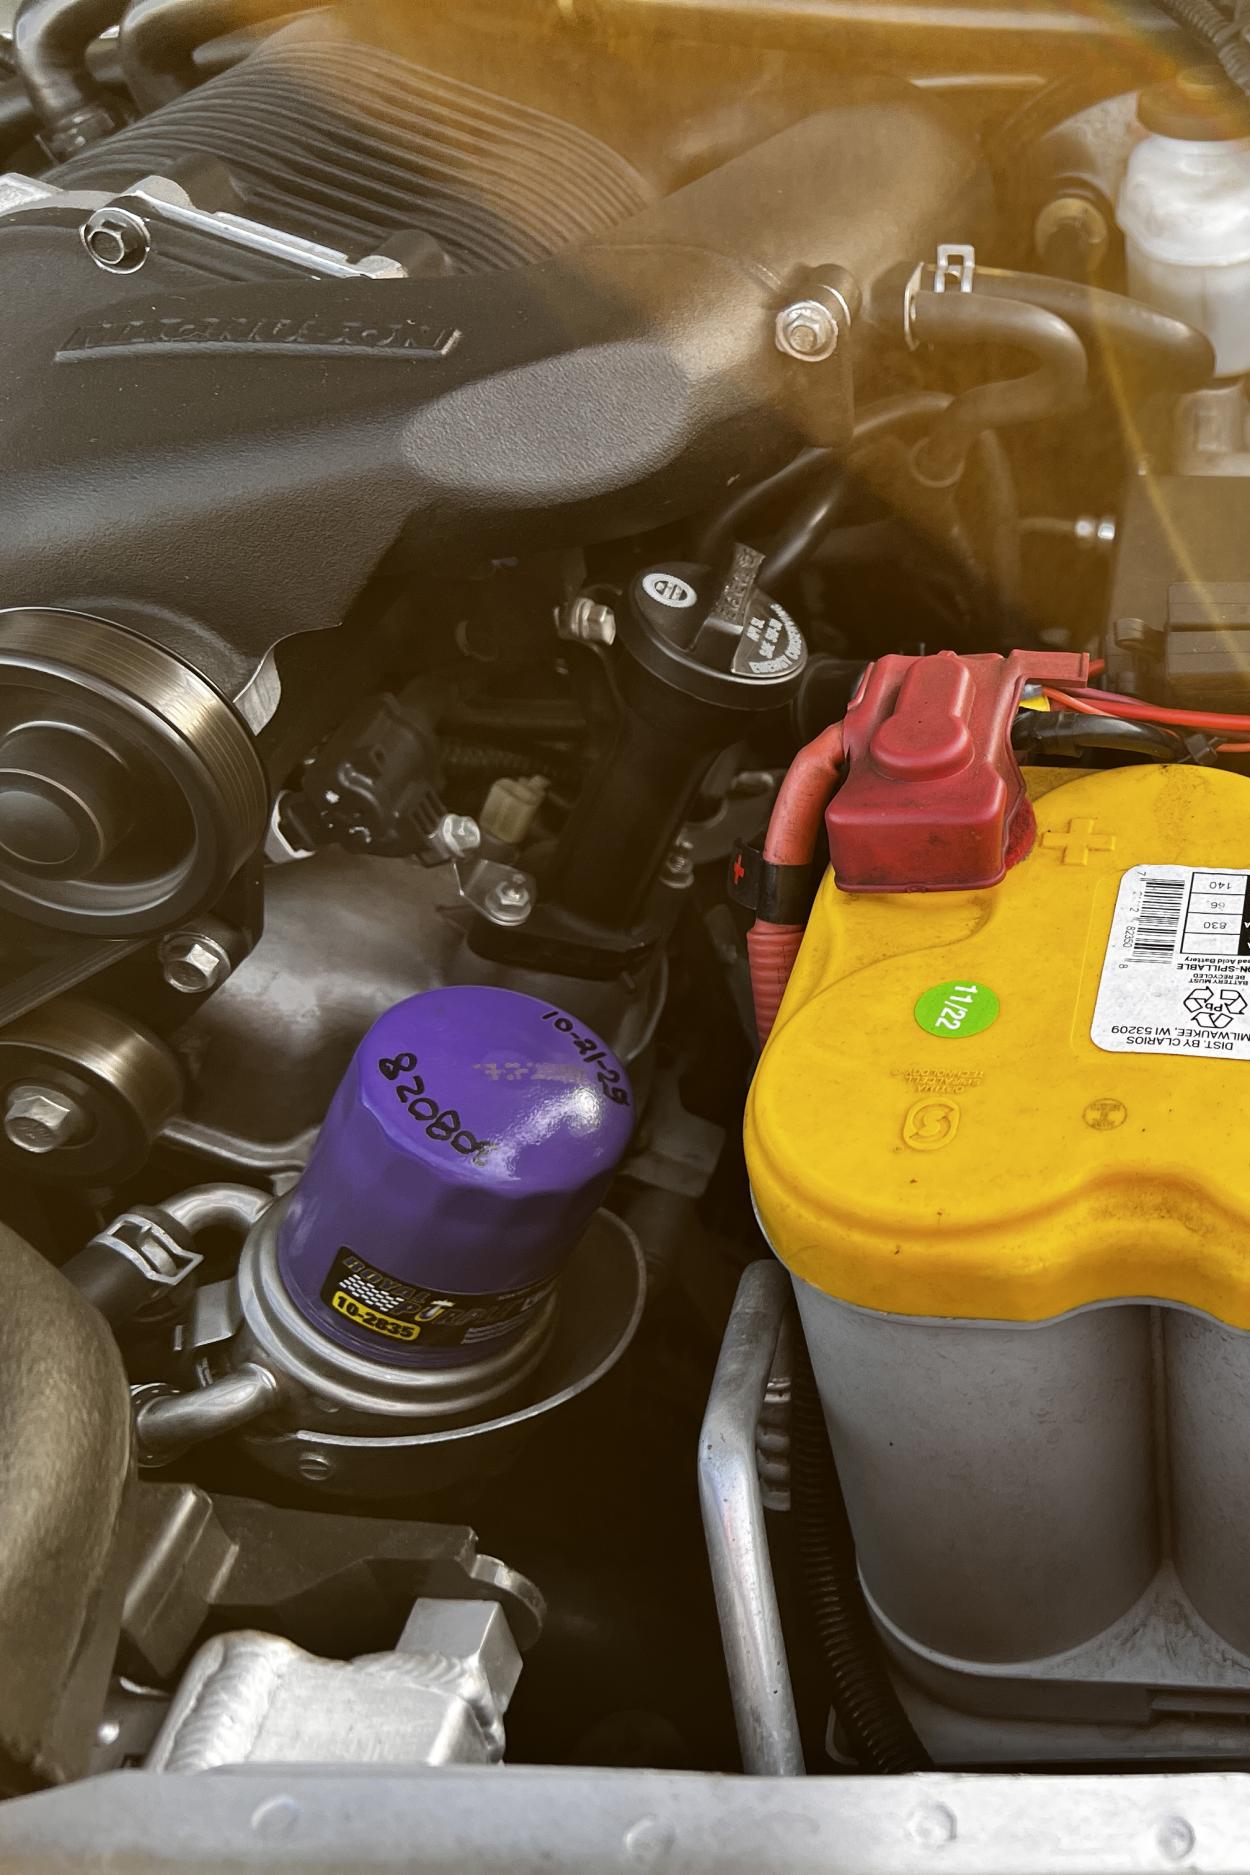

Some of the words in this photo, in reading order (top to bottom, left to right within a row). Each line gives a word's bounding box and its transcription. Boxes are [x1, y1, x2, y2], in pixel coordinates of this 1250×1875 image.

[1204, 921, 1227, 929] 830
[935, 986, 978, 1030] 11/22
[1205, 1003, 1222, 1011] Pb
[1111, 1026, 1152, 1035] 53209
[1156, 1027, 1170, 1035] WI
[1175, 1027, 1250, 1041] MILWAUKEE,
[1126, 1036, 1180, 1046] CLARIOS
[1184, 1039, 1200, 1048] BY
[1204, 1040, 1233, 1051] DIST.
[336, 1295, 416, 1338] 10-2835
